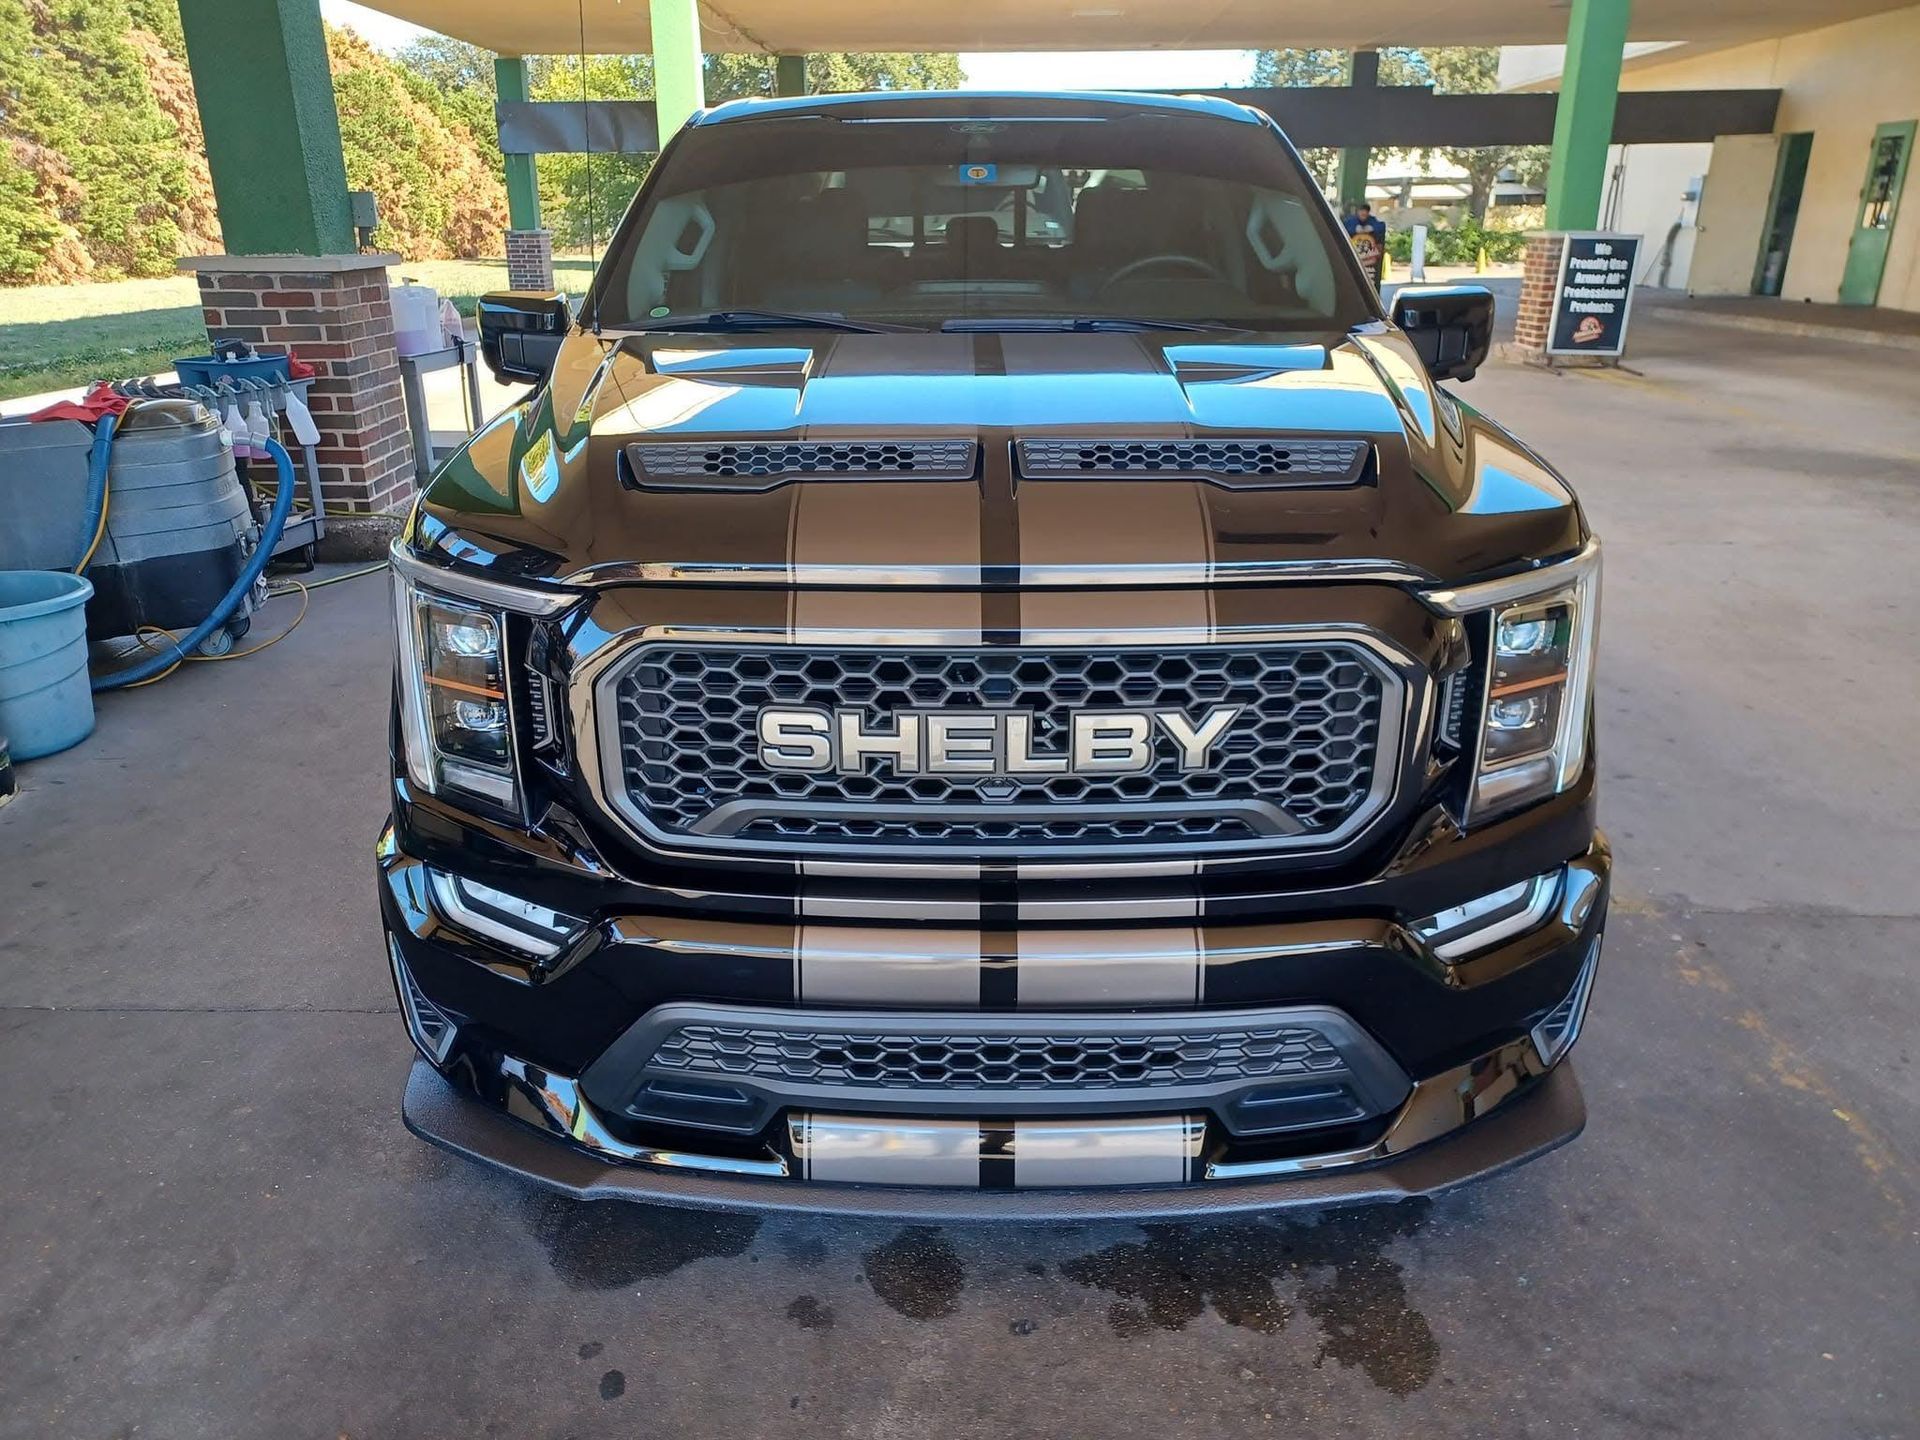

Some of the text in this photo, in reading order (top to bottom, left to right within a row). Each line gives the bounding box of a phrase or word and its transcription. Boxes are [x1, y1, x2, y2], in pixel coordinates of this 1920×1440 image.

[1594, 242, 1613, 255] We
[1569, 257, 1629, 270] Proudly Use
[1574, 272, 1606, 284] Armor
[1563, 286, 1626, 299] Professional
[1569, 301, 1615, 314] Products
[758, 706, 1243, 775] SHELBY
